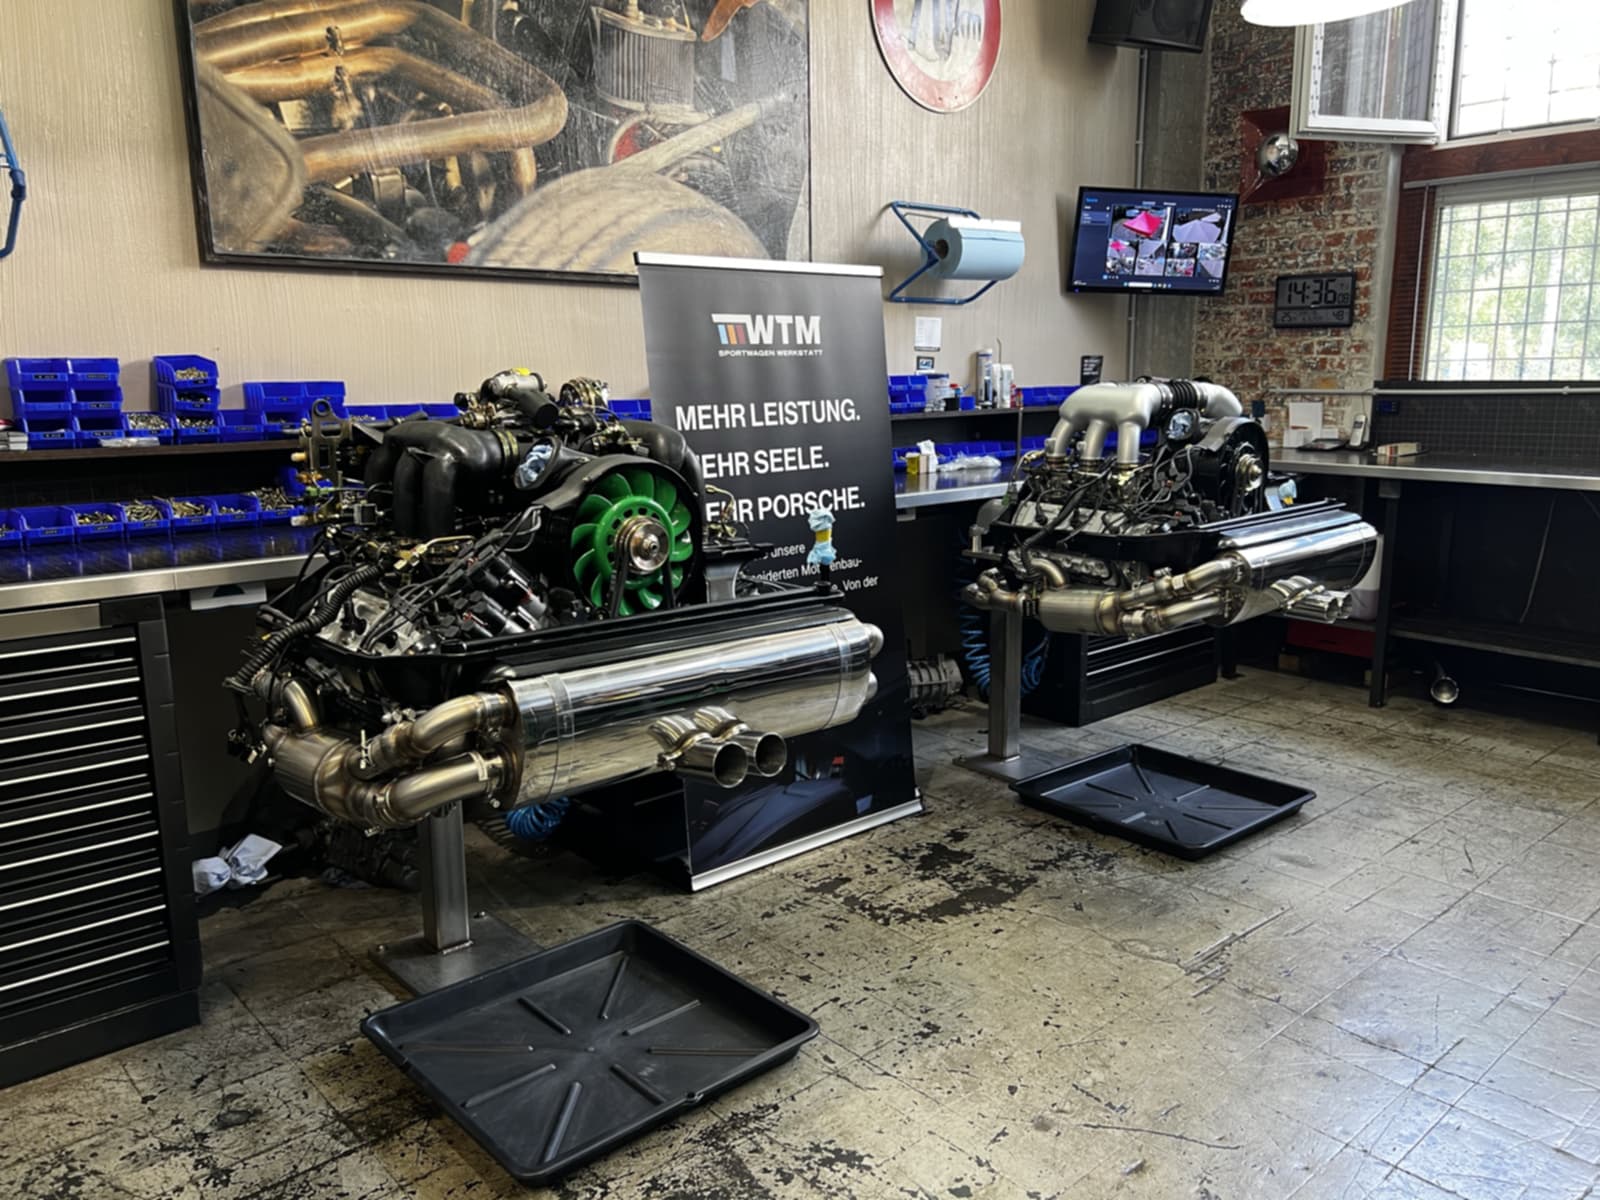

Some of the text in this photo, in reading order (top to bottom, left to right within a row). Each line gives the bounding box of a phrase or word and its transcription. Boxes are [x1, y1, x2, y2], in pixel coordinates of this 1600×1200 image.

[1288, 278, 1336, 305] 14:36
[745, 314, 821, 345] WTM
[718, 349, 823, 358] SPORTWAGEN WERKSTATT
[675, 399, 861, 431] MEHR LEISTUNG.
[696, 446, 830, 479] EHR SEELE.
[705, 486, 866, 523] EHR PORSCHE.
[842, 579, 862, 592] Von
[863, 576, 879, 588] der
